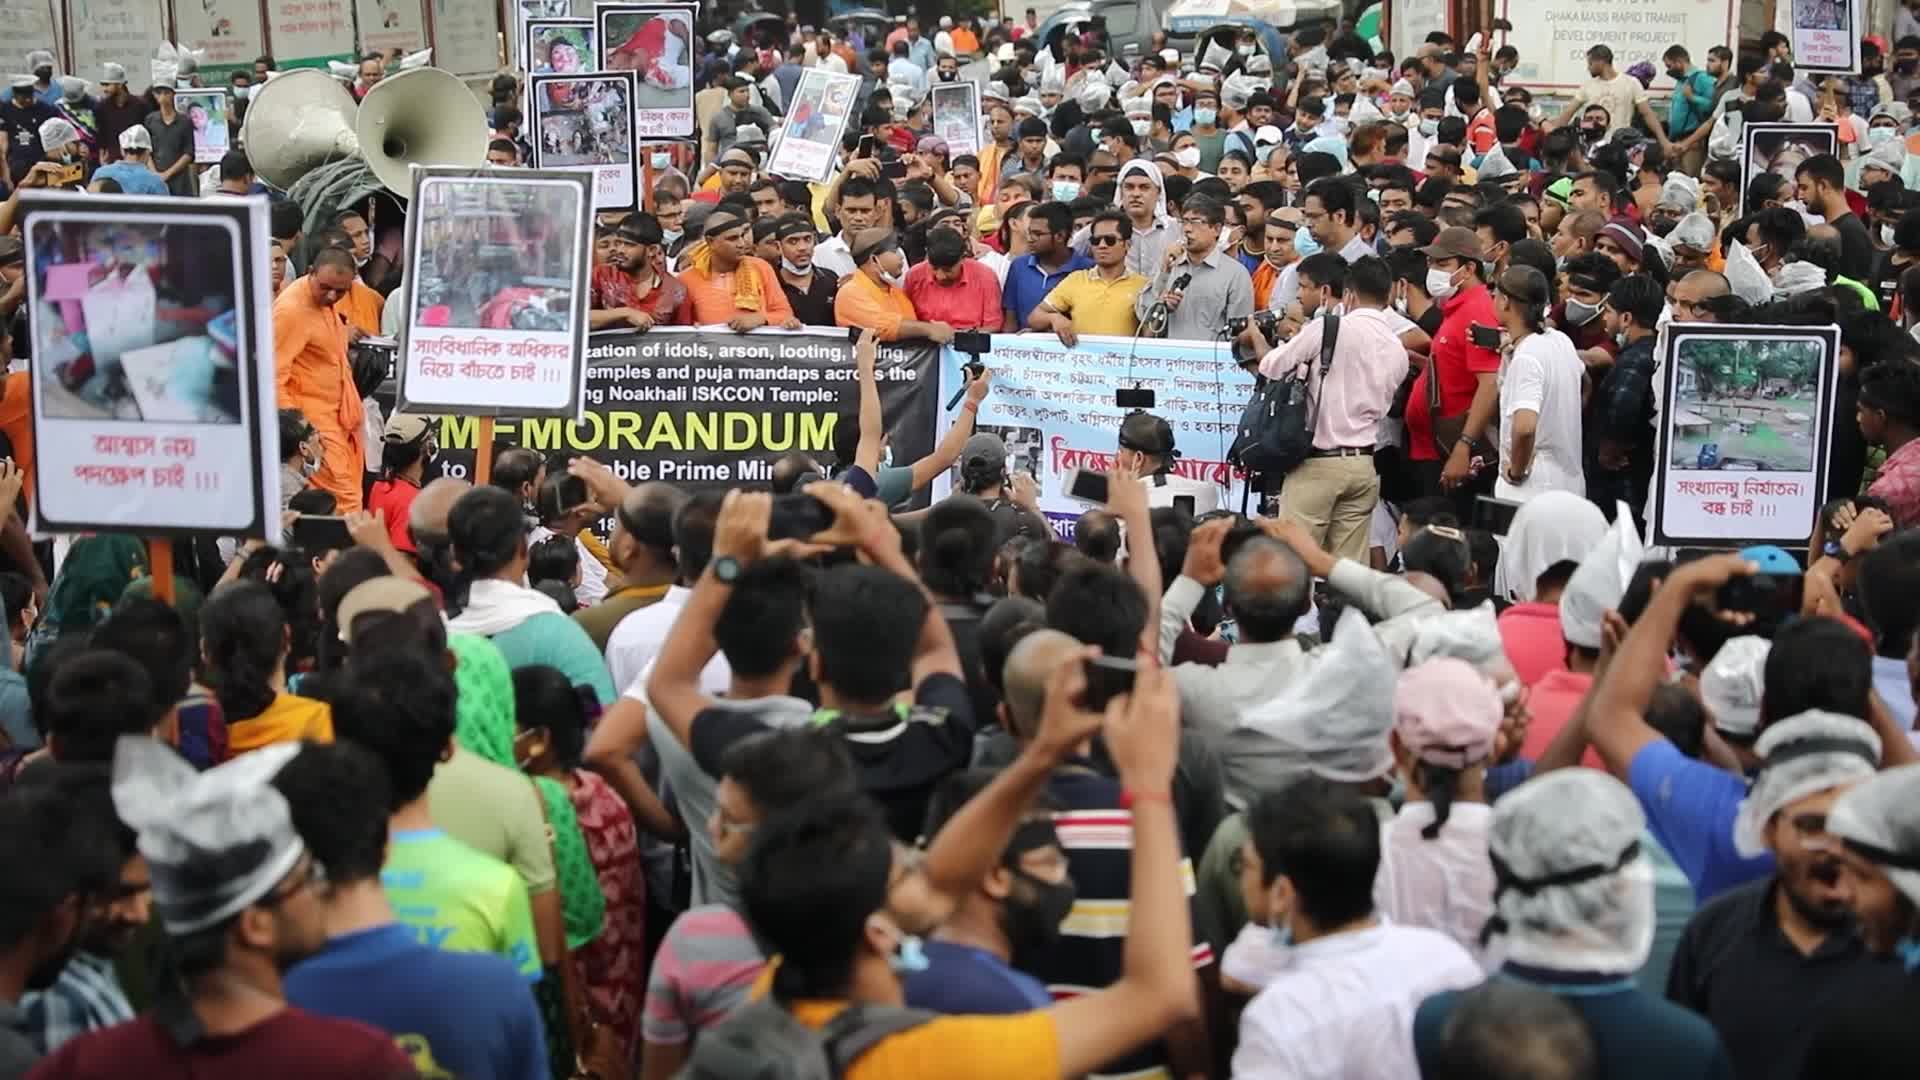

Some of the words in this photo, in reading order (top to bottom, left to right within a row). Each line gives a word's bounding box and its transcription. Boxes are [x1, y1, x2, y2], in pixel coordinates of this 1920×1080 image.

[1545, 10, 1580, 23] DHAKA
[1580, 11, 1609, 24] MASS
[1611, 12, 1642, 25] RAPID
[1645, 13, 1688, 25] TRANSIT
[1553, 30, 1628, 42] DEVELOPMENT
[1630, 31, 1677, 43] PROJECT
[1570, 50, 1626, 61] COCT
[415, 335, 501, 357] সাংবিধানিক
[507, 338, 569, 360] অধিকার
[586, 343, 636, 358] zation
[642, 342, 660, 358] of
[665, 343, 713, 360] idols,
[719, 346, 774, 360] arson,
[780, 344, 846, 361] looting,
[420, 357, 454, 378] নিয়ে
[460, 360, 505, 380] বাঁচতে
[510, 362, 536, 381] চাই
[585, 364, 651, 382] emples
[656, 365, 689, 380] and
[695, 367, 733, 383] puja
[739, 365, 820, 383] mandaps
[825, 368, 884, 381] acros
[889, 366, 916, 381] the
[609, 385, 687, 401] Noakhali
[692, 387, 764, 402] ISKCON
[769, 387, 839, 405] Temple:
[152, 463, 186, 489] চাই
[441, 460, 467, 480] to
[659, 460, 730, 480] Prime
[1677, 479, 1739, 498] সংখ্যালঘু
[1702, 501, 1727, 515] বন্ধ
[1730, 499, 1754, 516] চাই
